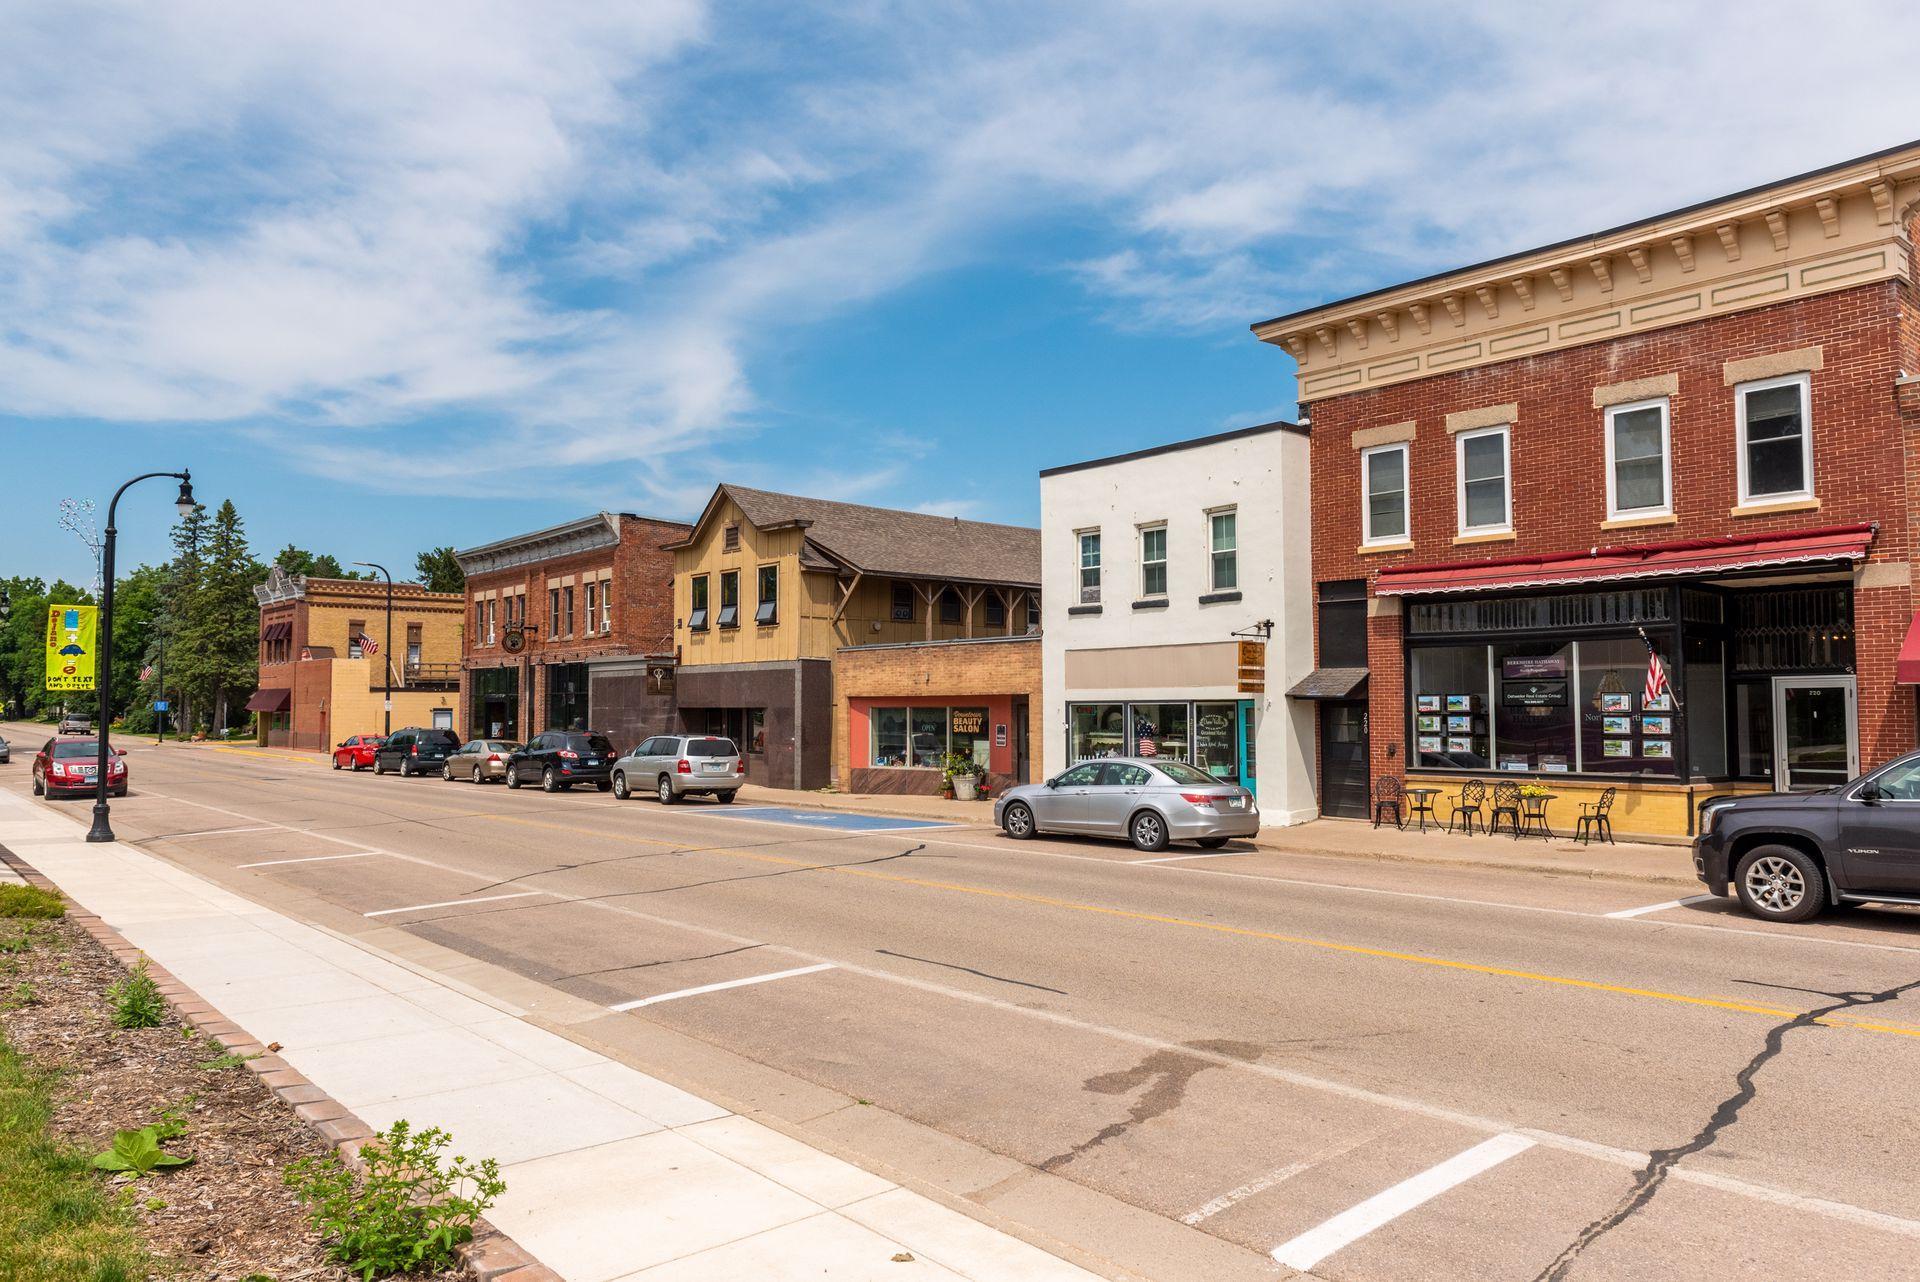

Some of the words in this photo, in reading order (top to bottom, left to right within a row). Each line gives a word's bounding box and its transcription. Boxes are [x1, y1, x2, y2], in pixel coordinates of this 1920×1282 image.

[50, 610, 60, 648] Delano
[48, 675, 68, 683] DON'T
[953, 717, 983, 725] BEAUTY
[1585, 713, 1600, 721] Nor
[922, 724, 936, 732] OPEN
[953, 725, 980, 733] SALON
